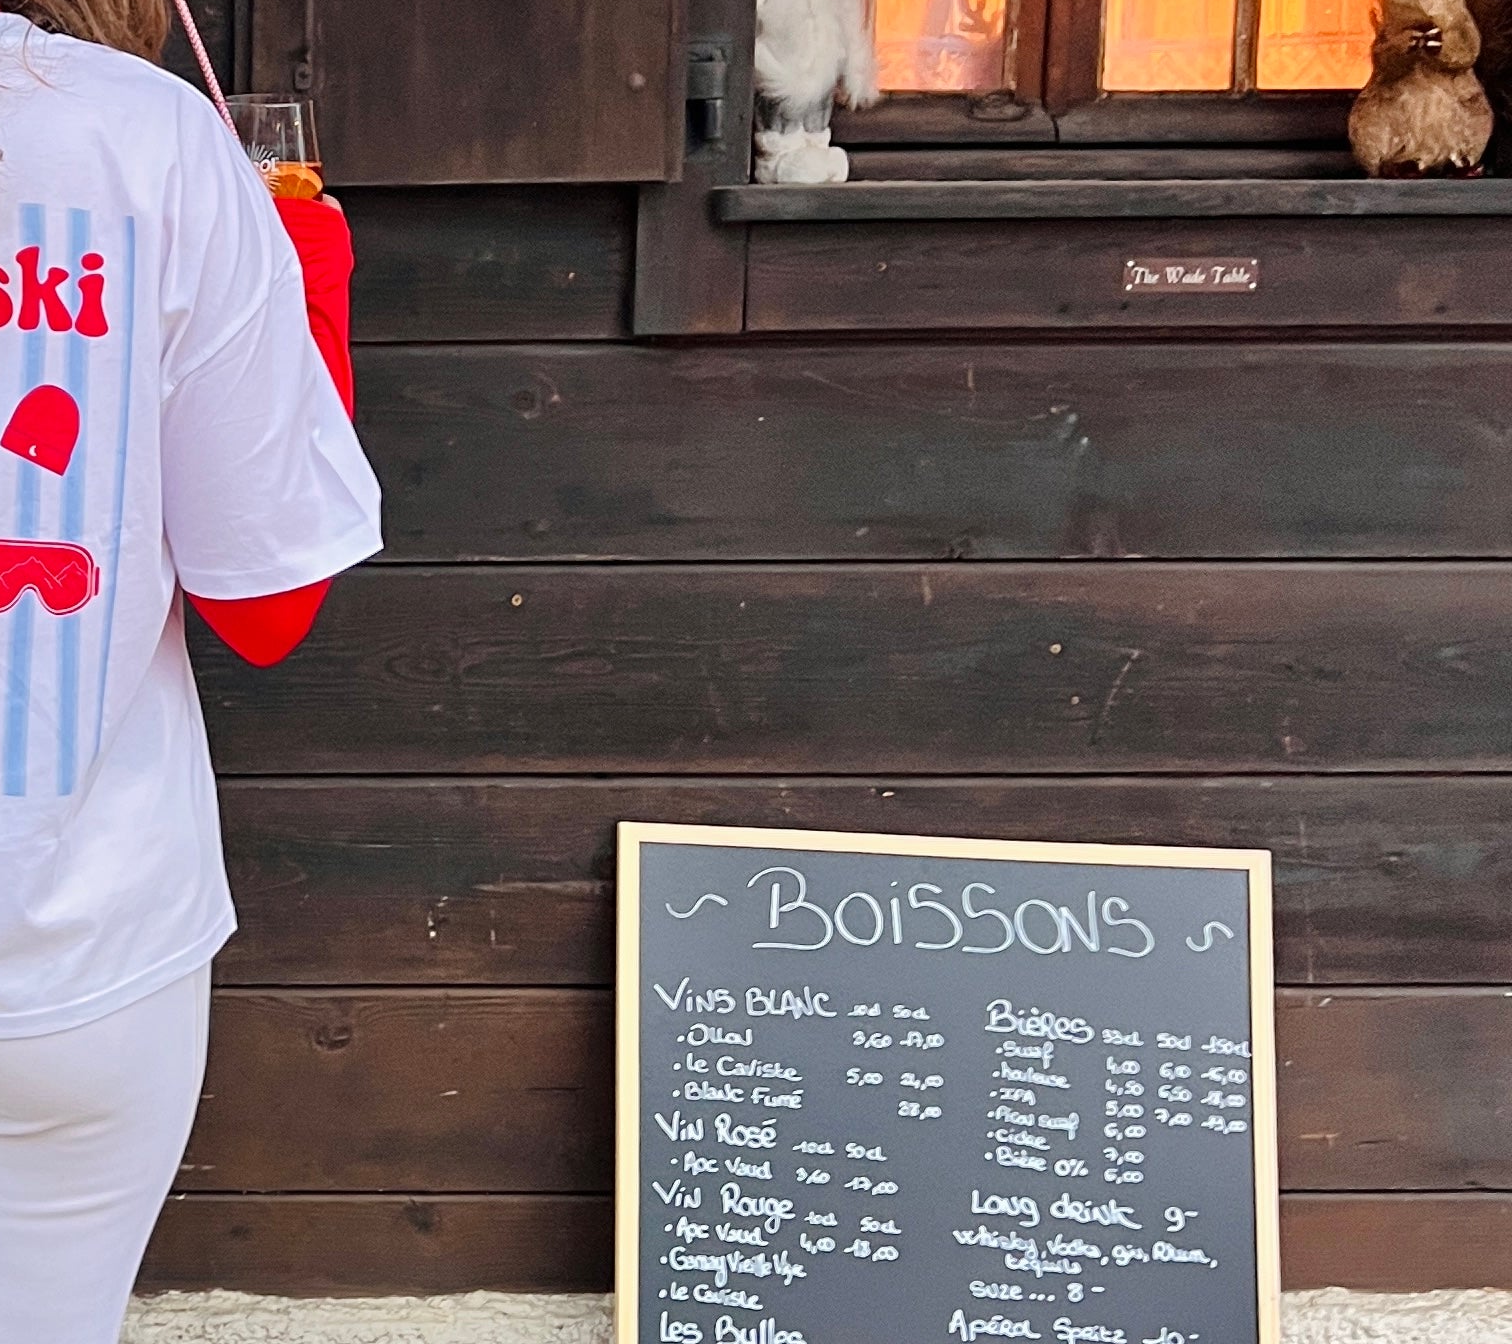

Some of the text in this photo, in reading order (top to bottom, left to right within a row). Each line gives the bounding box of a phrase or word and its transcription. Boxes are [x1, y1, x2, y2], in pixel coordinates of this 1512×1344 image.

[1130, 266, 1160, 285] The
[1210, 265, 1252, 284] Table
[745, 985, 838, 1020] BLANC
[846, 1067, 884, 1087] 5,00
[1053, 1158, 1089, 1177] 0%
[717, 1182, 796, 1237] Rouge
